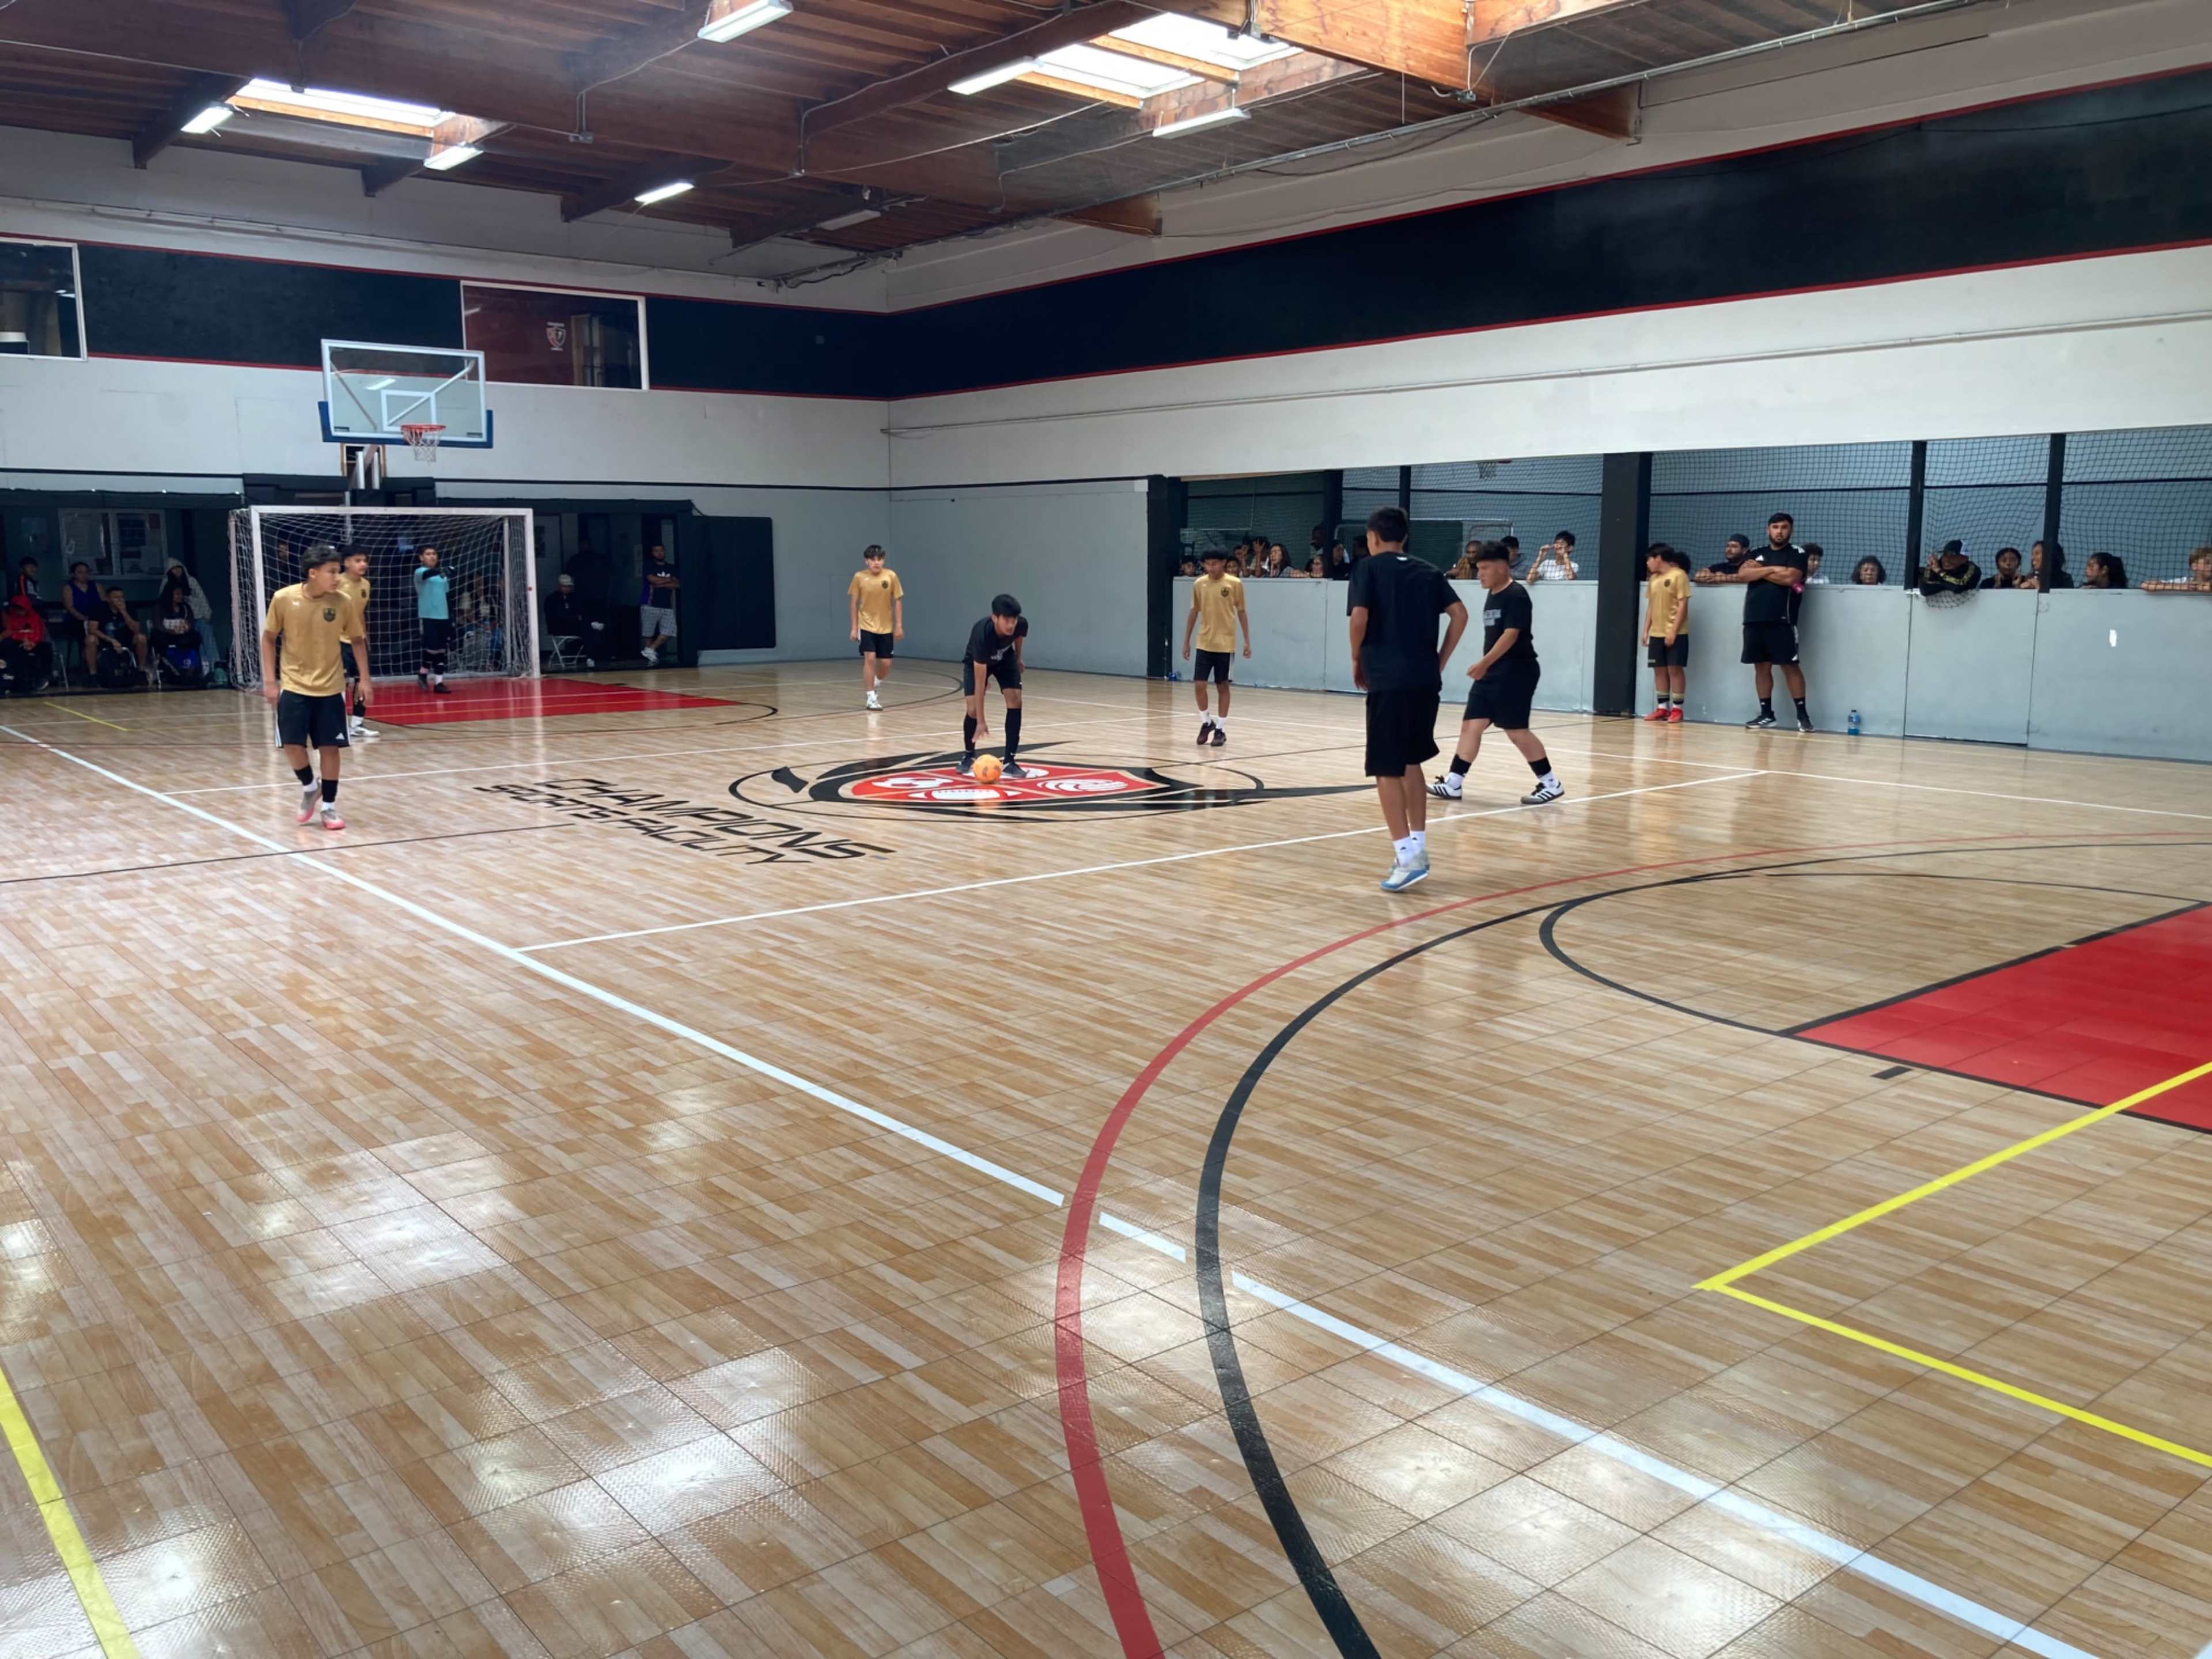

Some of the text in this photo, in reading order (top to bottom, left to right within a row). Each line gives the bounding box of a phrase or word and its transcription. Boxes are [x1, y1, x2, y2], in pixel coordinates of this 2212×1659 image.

[473, 784, 812, 865] SPORTS FACILITY
[533, 778, 896, 859] CHAMPIONS
